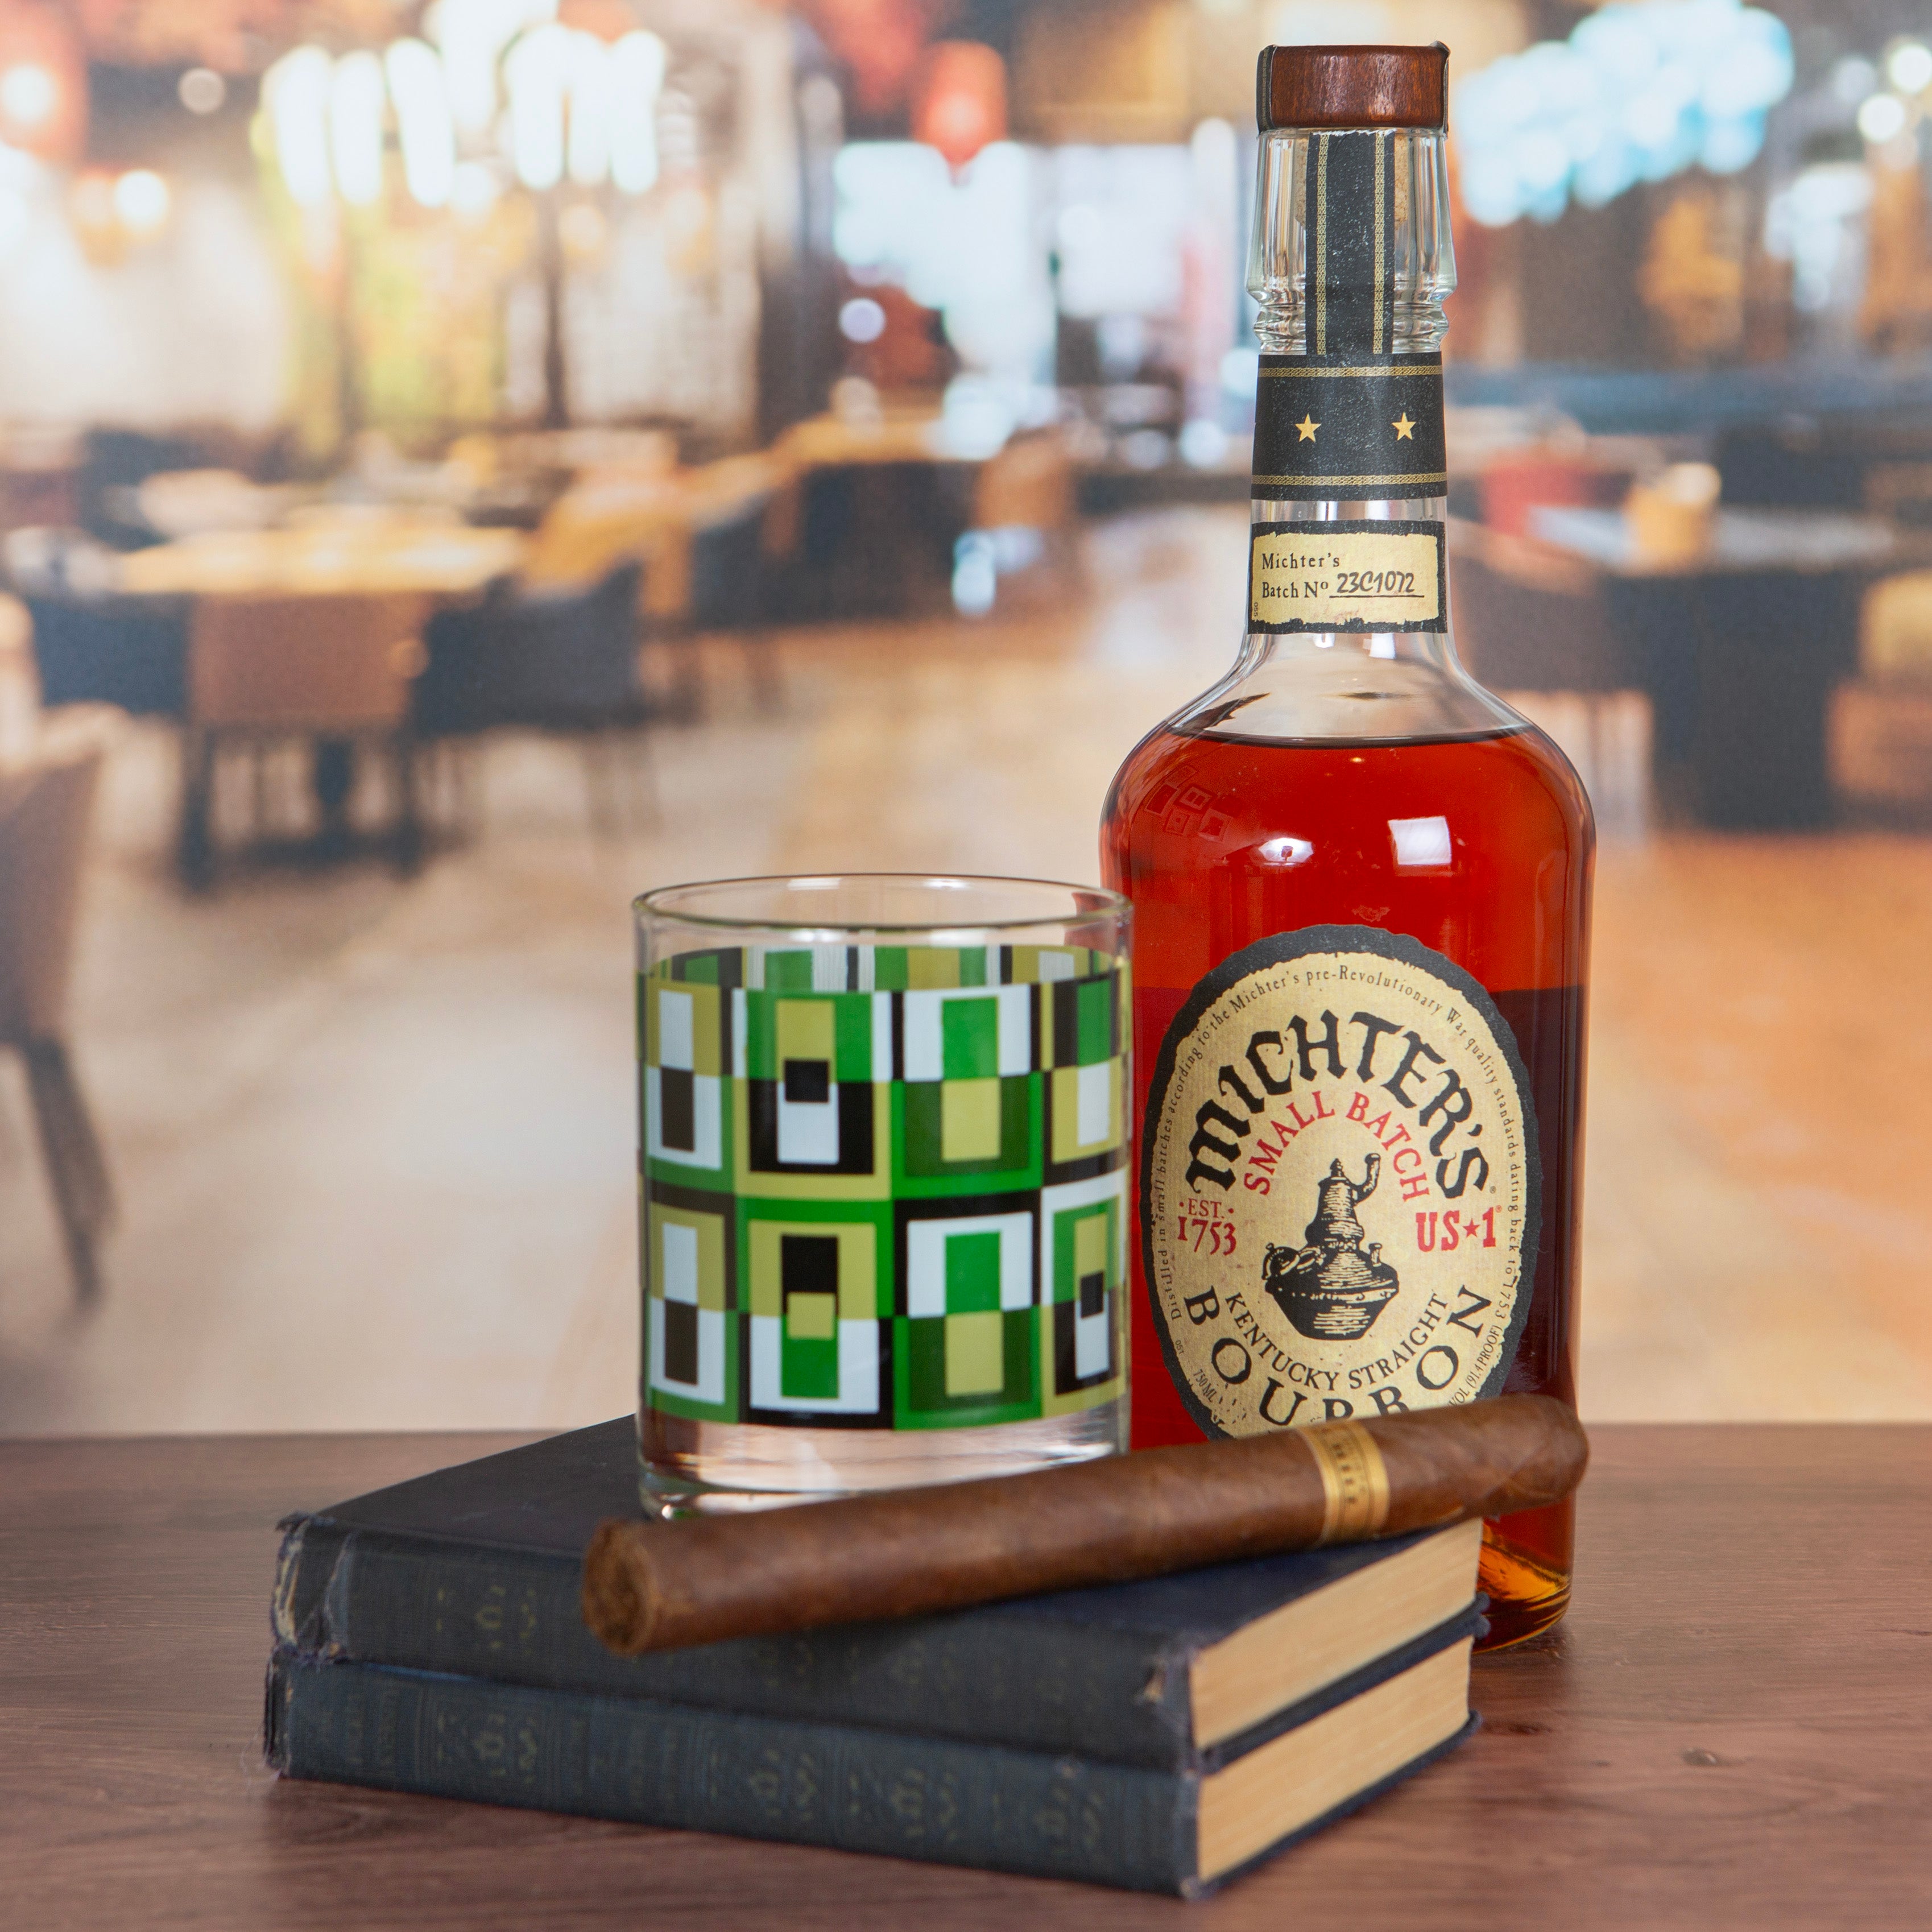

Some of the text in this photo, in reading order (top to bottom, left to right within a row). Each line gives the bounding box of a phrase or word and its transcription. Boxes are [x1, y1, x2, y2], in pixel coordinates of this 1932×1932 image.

[1262, 552, 1340, 569] Michter's
[1262, 581, 1299, 598] Batch
[1186, 1010, 1489, 1199] MICHTER'S
[1155, 965, 1521, 1320] Distilled in small batches according to the Michter's pre-Revolutionary War quality standards dating back to 1753
[1244, 1090, 1430, 1201] SMALL BATCH
[1177, 1216, 1236, 1256] 1753
[1225, 1292, 1448, 1391] KENTUCKY STRAIGHT
[1477, 1325, 1503, 1367] PROOF)
